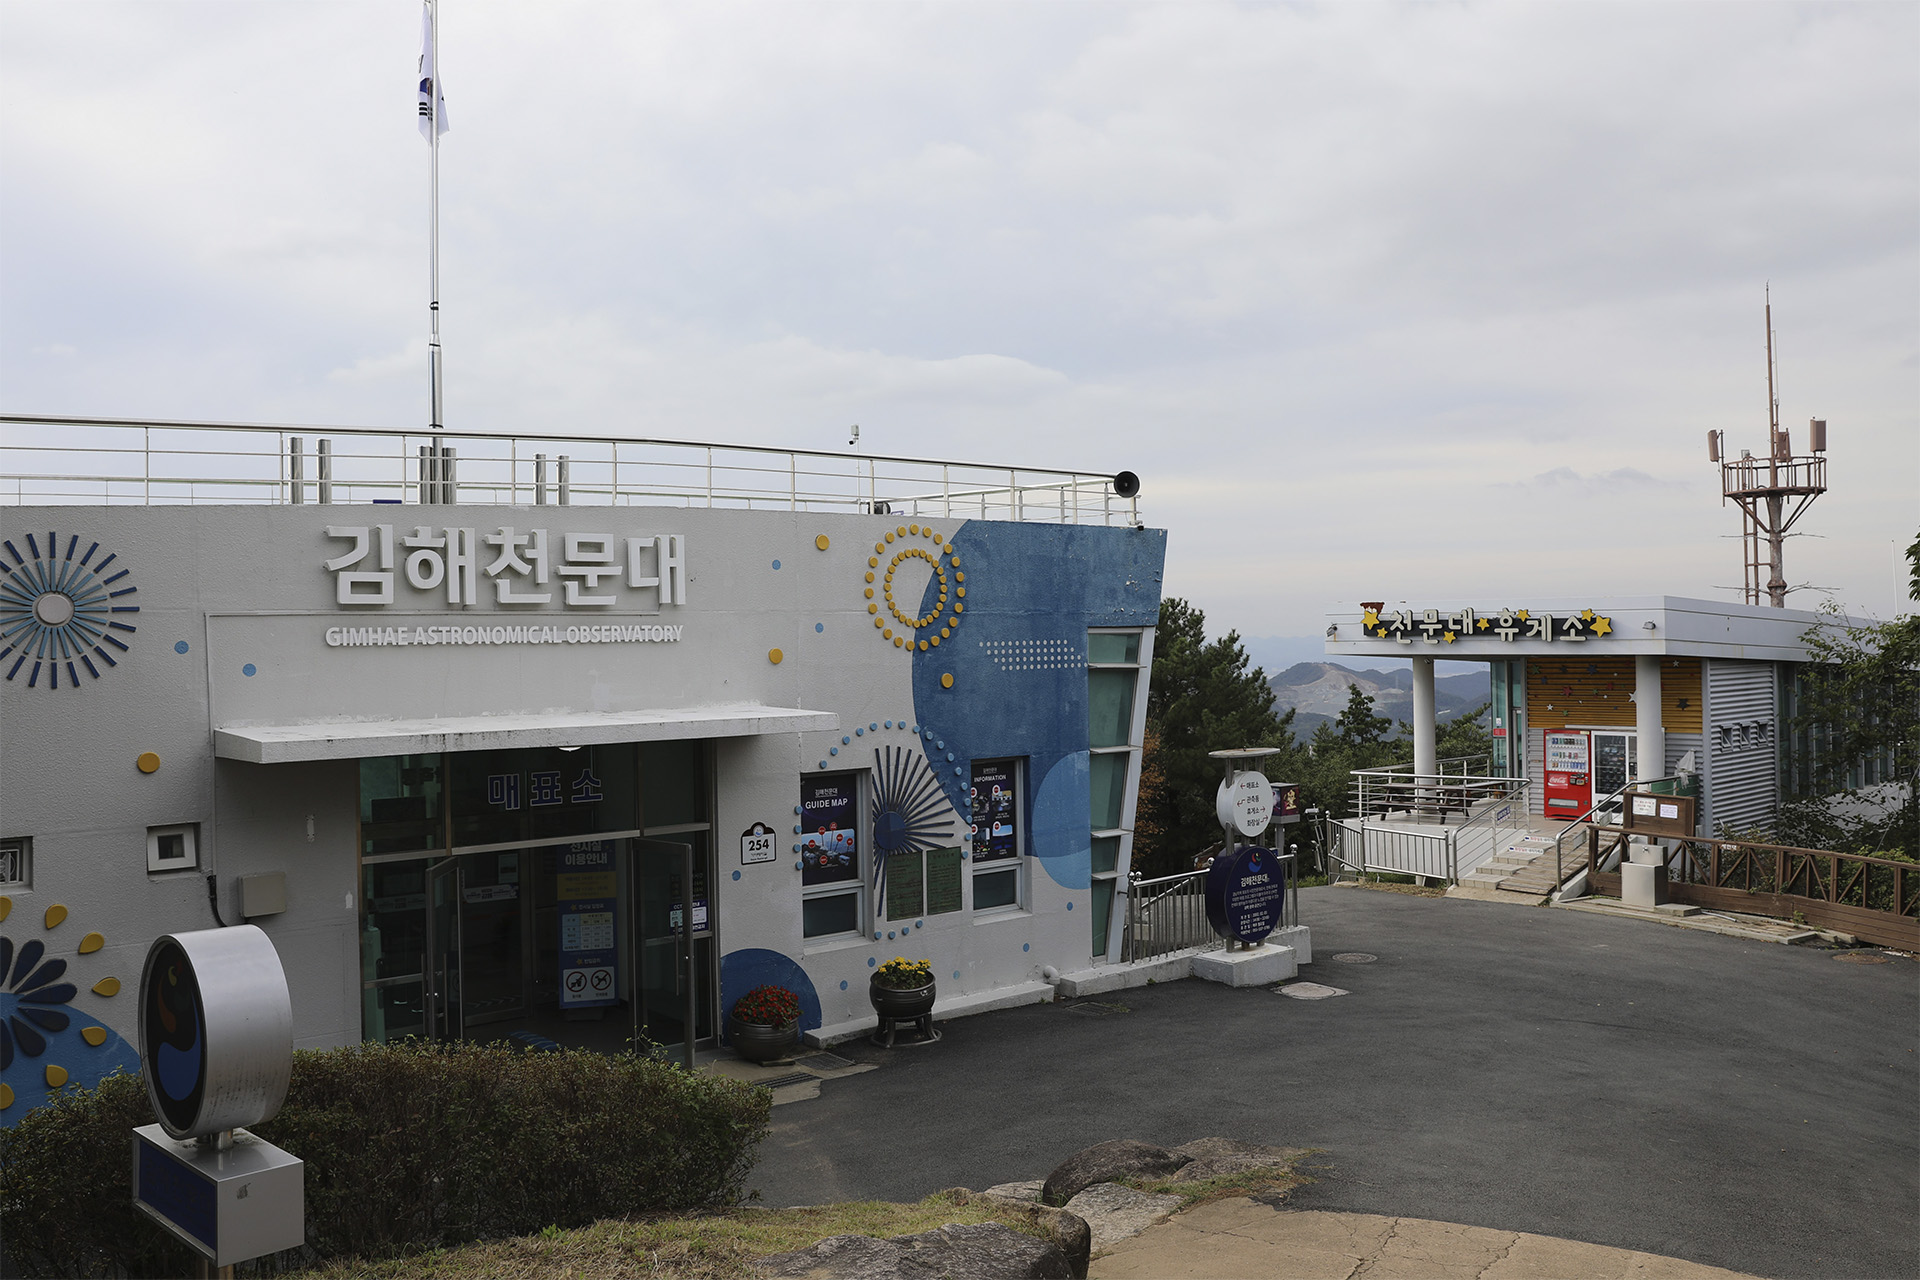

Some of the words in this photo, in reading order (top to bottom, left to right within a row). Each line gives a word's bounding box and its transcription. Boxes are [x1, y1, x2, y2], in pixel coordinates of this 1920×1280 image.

[324, 524, 686, 606] 김해천문대
[1390, 607, 1474, 644] 천문대
[1494, 607, 1587, 643] 휴게소
[325, 627, 408, 647] GIMHAE
[414, 626, 562, 646] ASTRONOMICAL
[566, 625, 684, 645] OBSERVATORY
[974, 774, 1006, 782] INFORMATION
[487, 768, 603, 810] 매표소
[1246, 781, 1259, 789] 매표소
[805, 799, 830, 809] GUIDE
[831, 798, 848, 807] MAP
[1246, 819, 1260, 827] 화장실
[748, 838, 770, 851] 254
[565, 852, 608, 866] 이용안내
